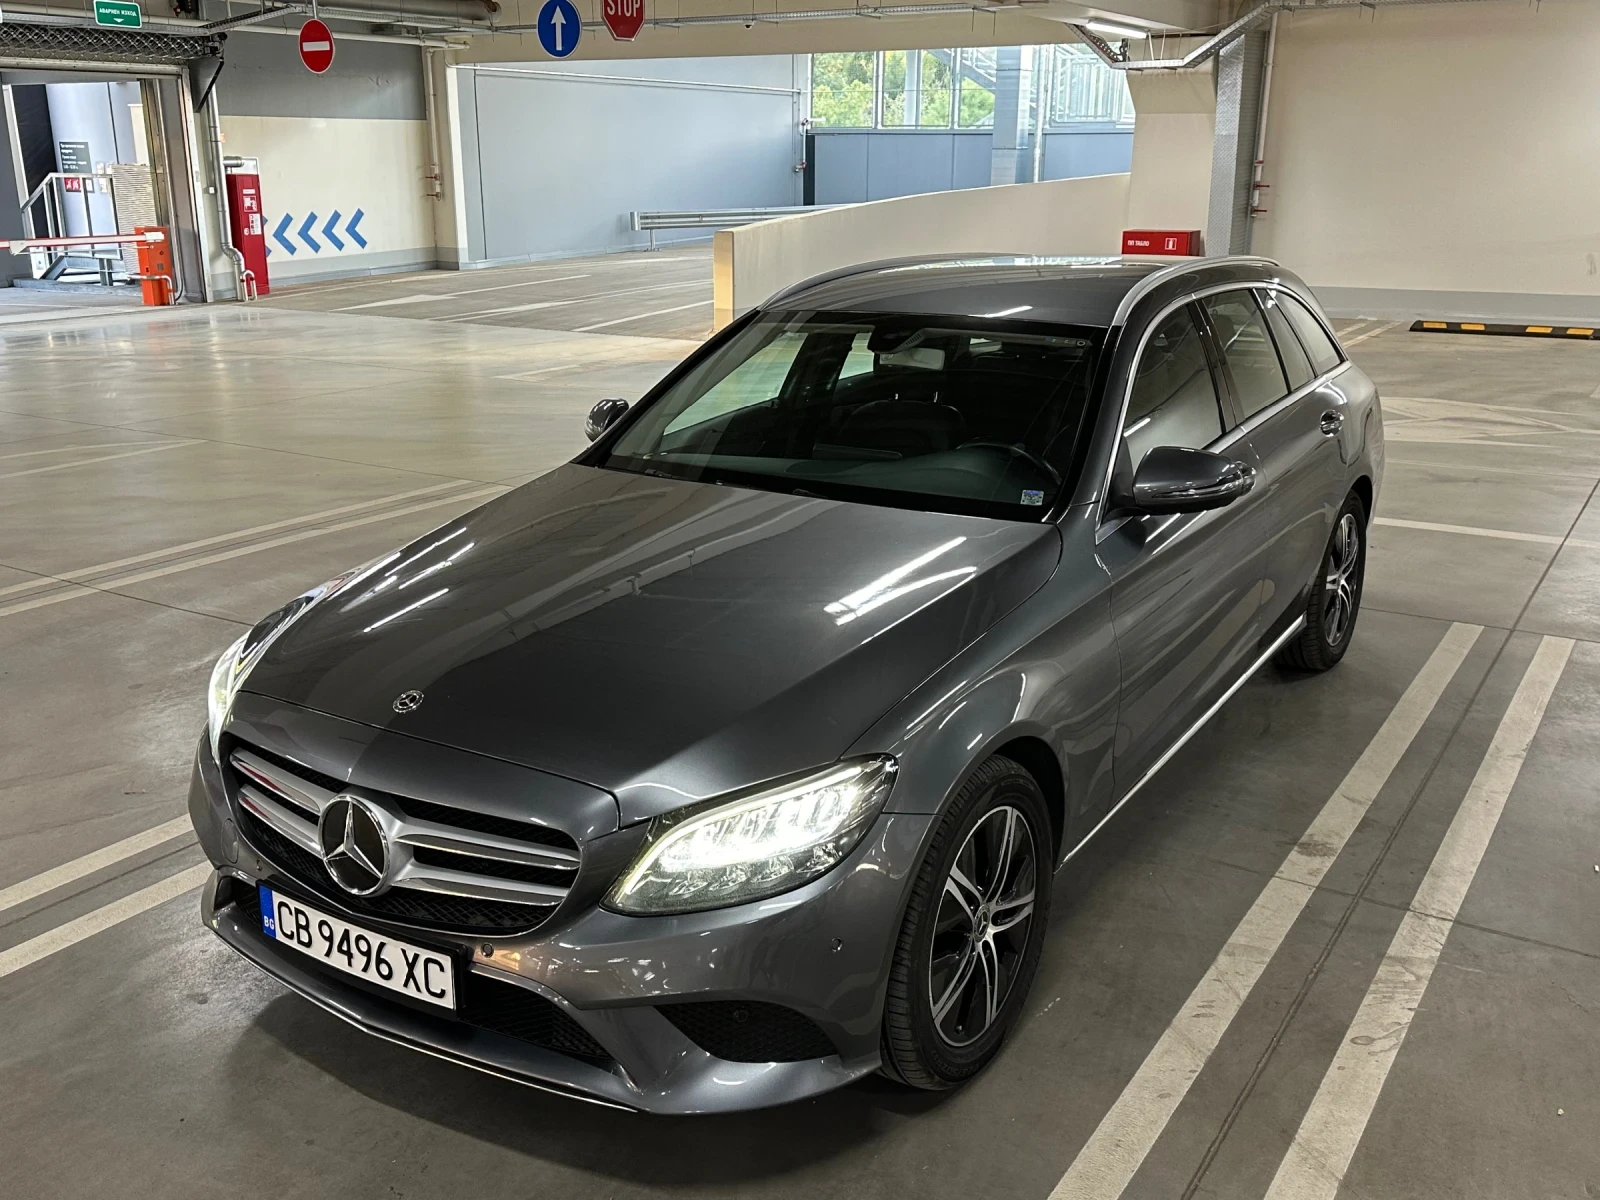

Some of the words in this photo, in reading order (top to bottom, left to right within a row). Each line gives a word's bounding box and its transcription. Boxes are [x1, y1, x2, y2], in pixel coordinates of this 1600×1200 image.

[263, 915, 275, 930] BG
[277, 901, 313, 948] CB
[317, 920, 394, 981] 9496
[400, 947, 447, 999] XC
